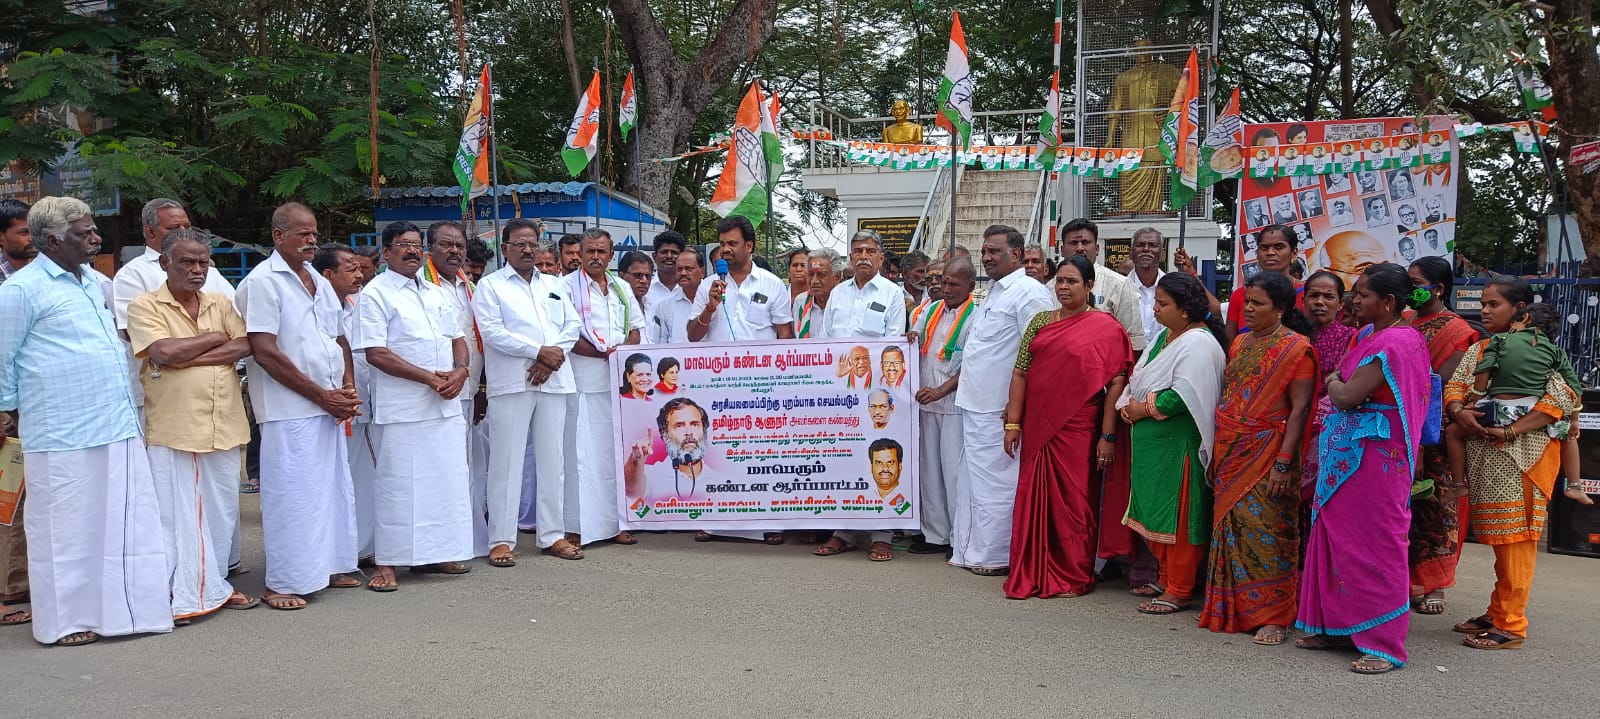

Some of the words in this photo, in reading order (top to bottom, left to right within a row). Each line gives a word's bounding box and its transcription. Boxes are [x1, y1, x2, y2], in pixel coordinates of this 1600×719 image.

[684, 352, 730, 373] மாபெரும்
[734, 350, 772, 369] கண்டன
[775, 348, 833, 371] ஆர்ப்பாட்டம்
[711, 398, 780, 412] அரசியலமைப்பிற்கு
[783, 395, 815, 411] புறம்பாக
[817, 394, 860, 409] செயல்படும்
[712, 415, 752, 431] தமிழ்நாடு
[754, 413, 788, 429] ஆளுநர்
[789, 414, 827, 426] அவர்களை
[747, 460, 826, 476] மாபெரும்
[705, 480, 769, 493] கண்டன
[772, 477, 869, 494] ஆர்ப்பாட்டம்
